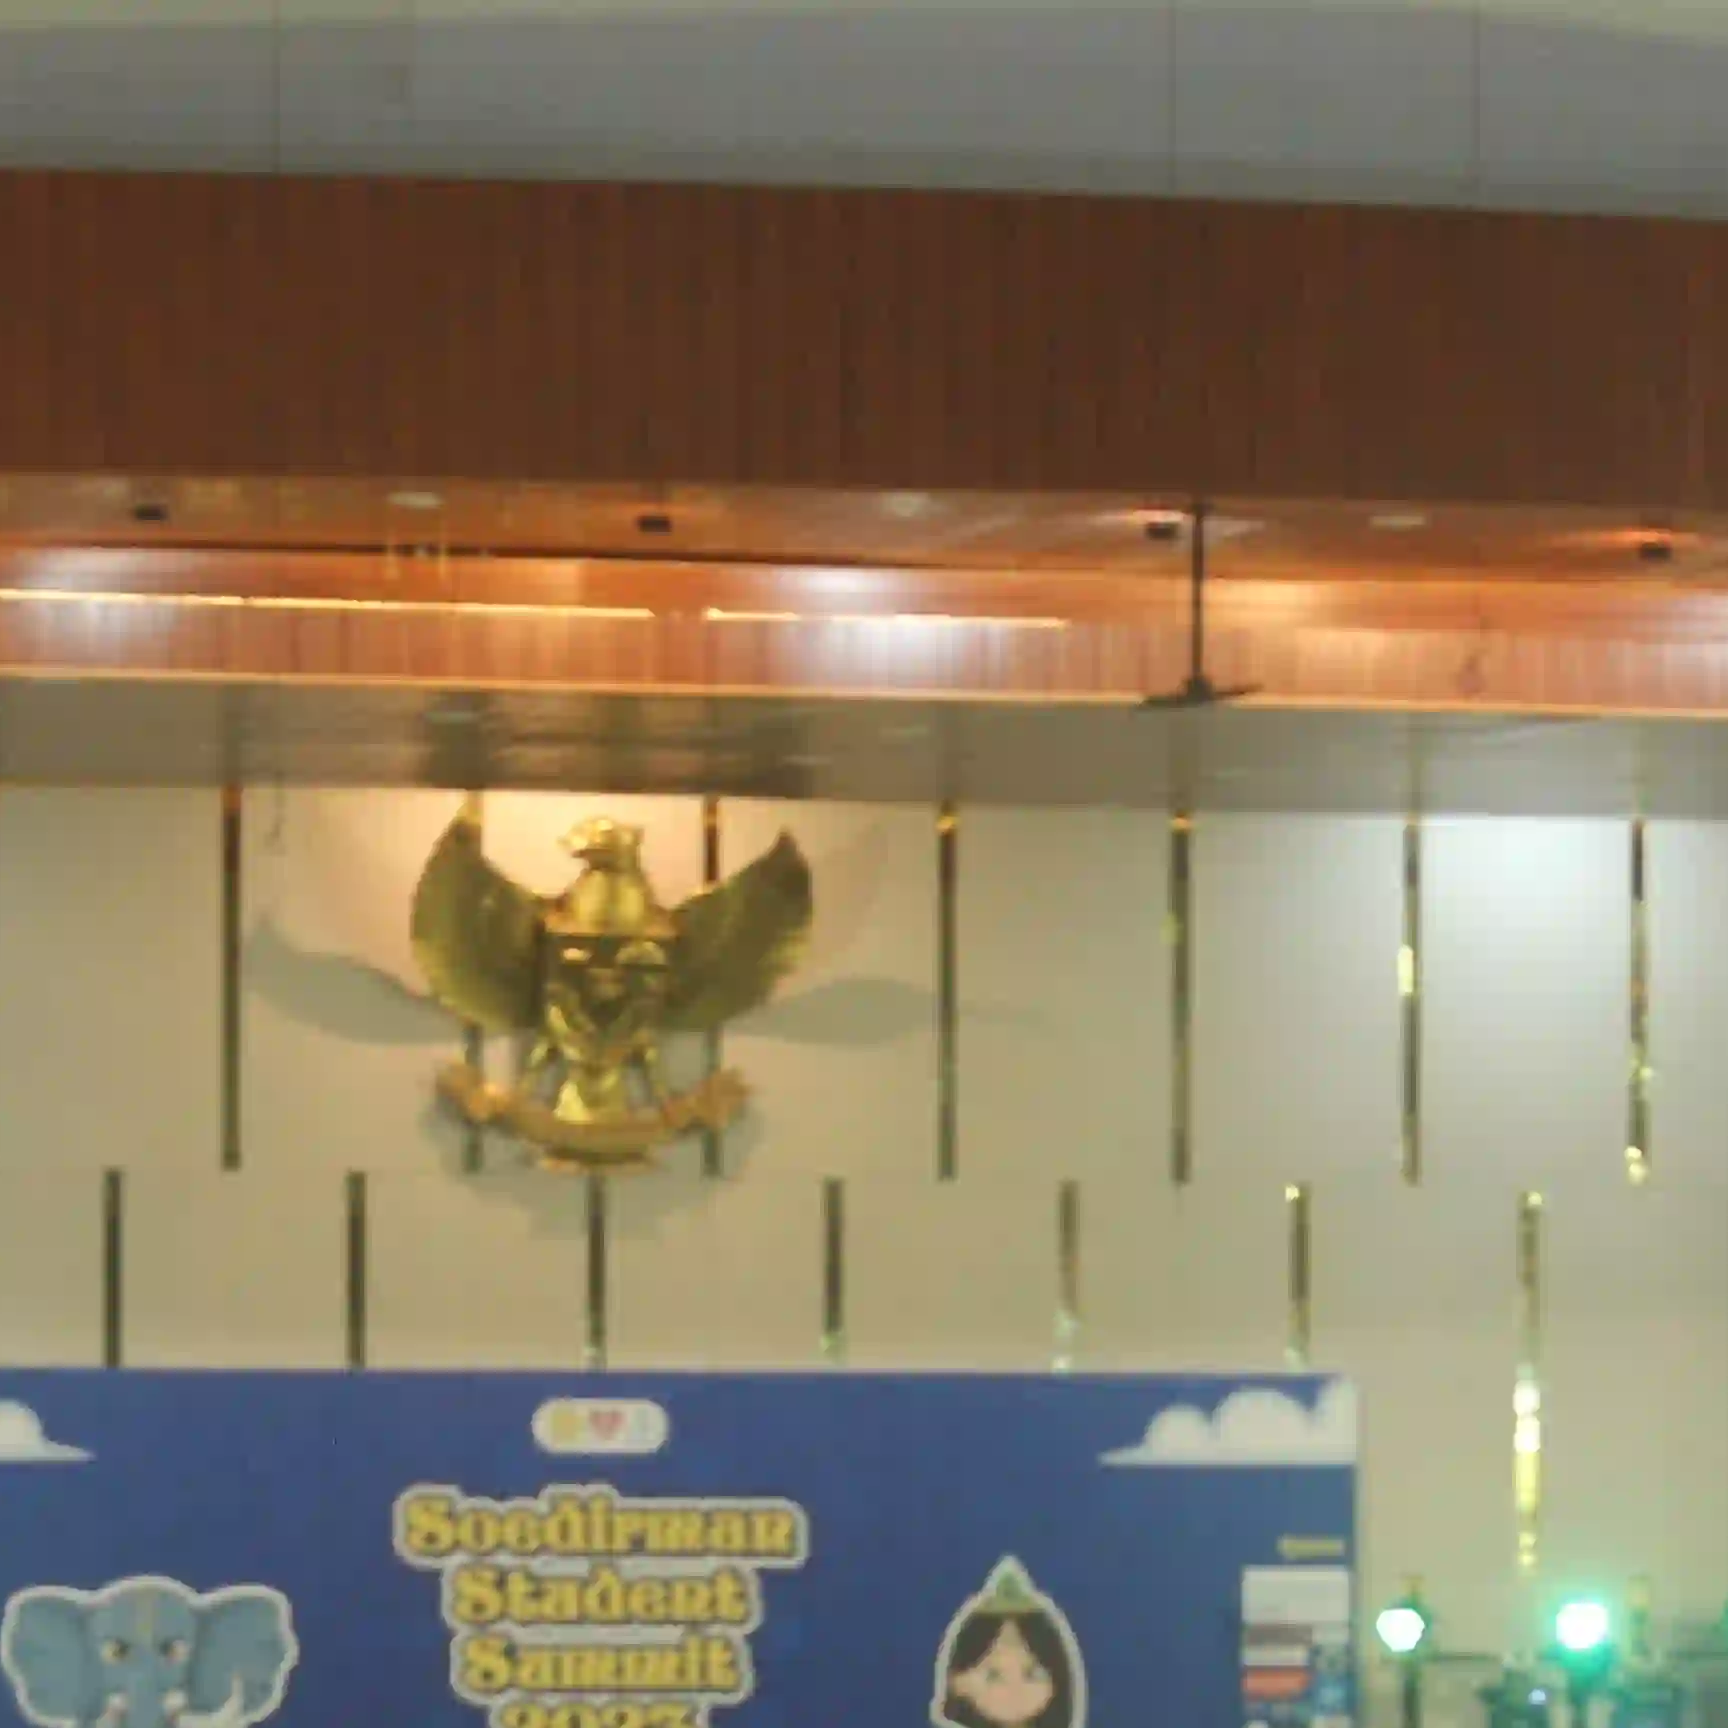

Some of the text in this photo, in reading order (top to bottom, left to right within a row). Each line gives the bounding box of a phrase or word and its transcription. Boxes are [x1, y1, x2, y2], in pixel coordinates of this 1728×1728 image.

[402, 1495, 798, 1558] Soedirman
[449, 1563, 750, 1626] Student
[461, 1632, 741, 1694] Summit
